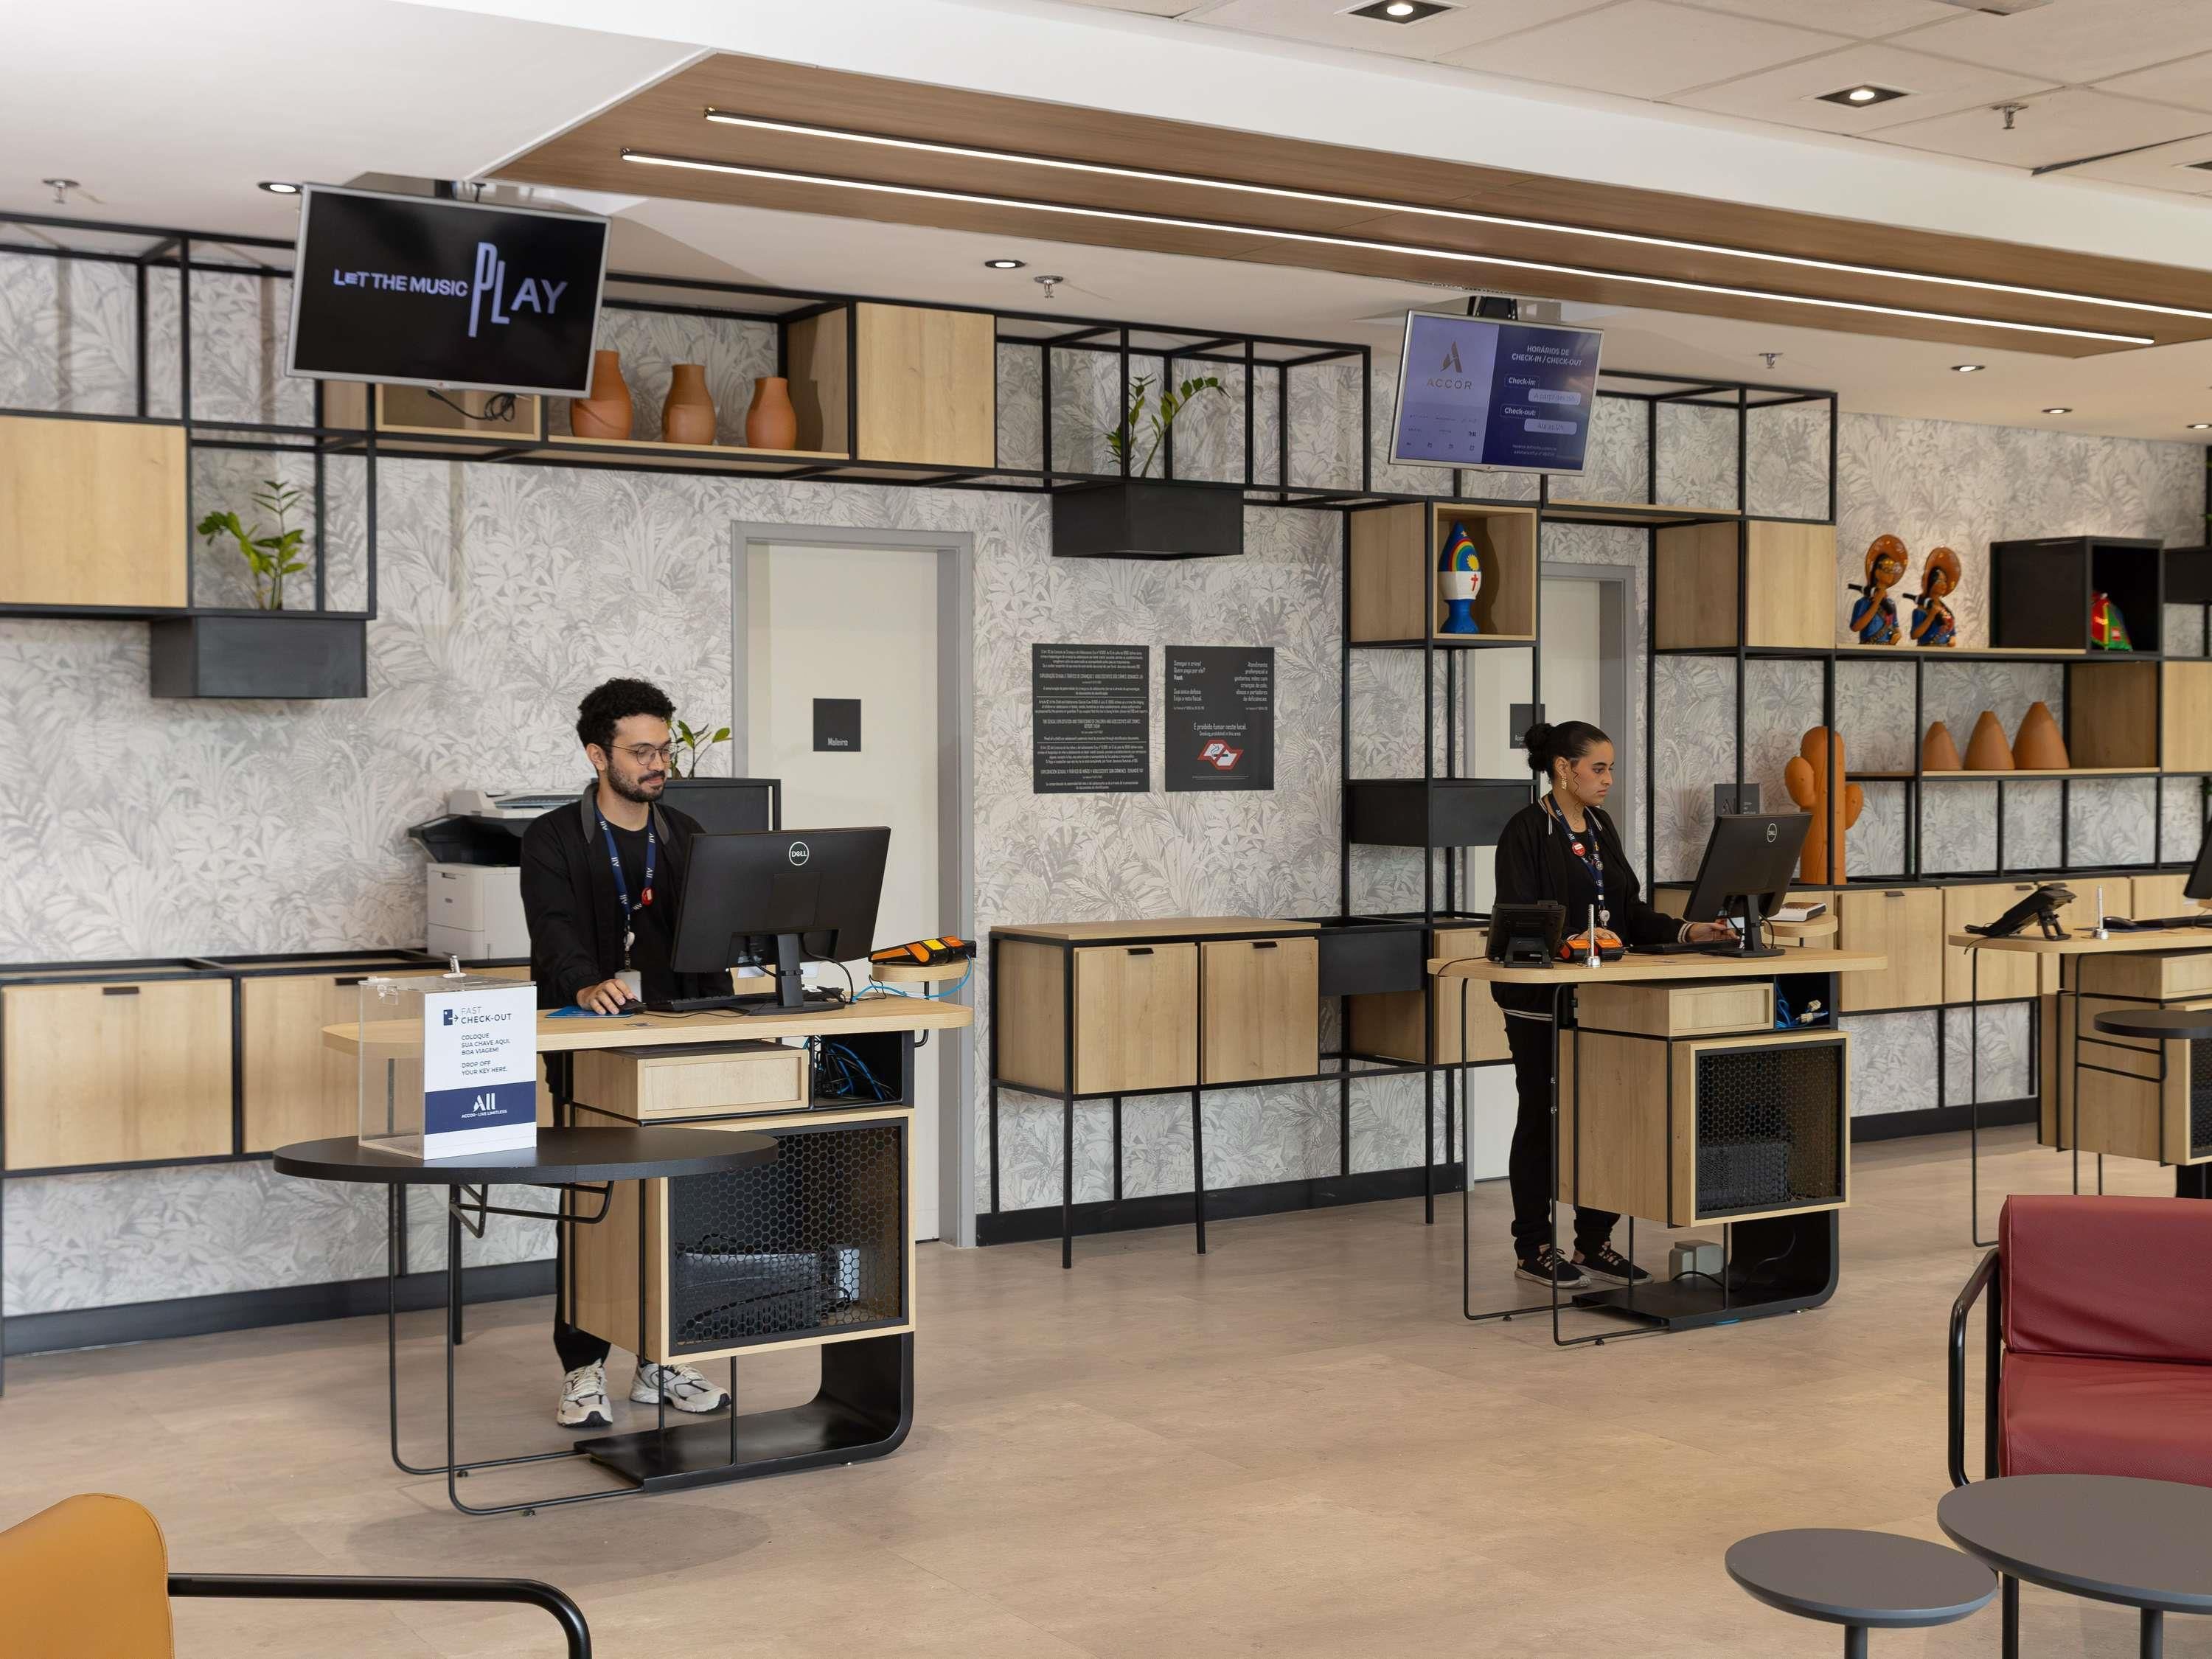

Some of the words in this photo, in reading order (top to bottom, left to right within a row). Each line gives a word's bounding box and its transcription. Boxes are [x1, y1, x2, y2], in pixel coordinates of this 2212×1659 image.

[371, 273, 408, 291] THE
[409, 276, 468, 297] MUSIC
[467, 241, 568, 338] PLAY
[1527, 344, 1559, 355] HORÁRIOS
[1560, 348, 1570, 356] DE
[1512, 352, 1542, 364] CHECK-IN
[1546, 357, 1582, 366] CHECK-OUT
[1427, 378, 1474, 391] ACCOR
[1509, 377, 1536, 386] Check-in:
[1504, 407, 1537, 416] Check-out:
[462, 1006, 482, 1015] FAST
[461, 1013, 512, 1024] CHECK-OUT
[462, 1032, 490, 1040] COLOQUE
